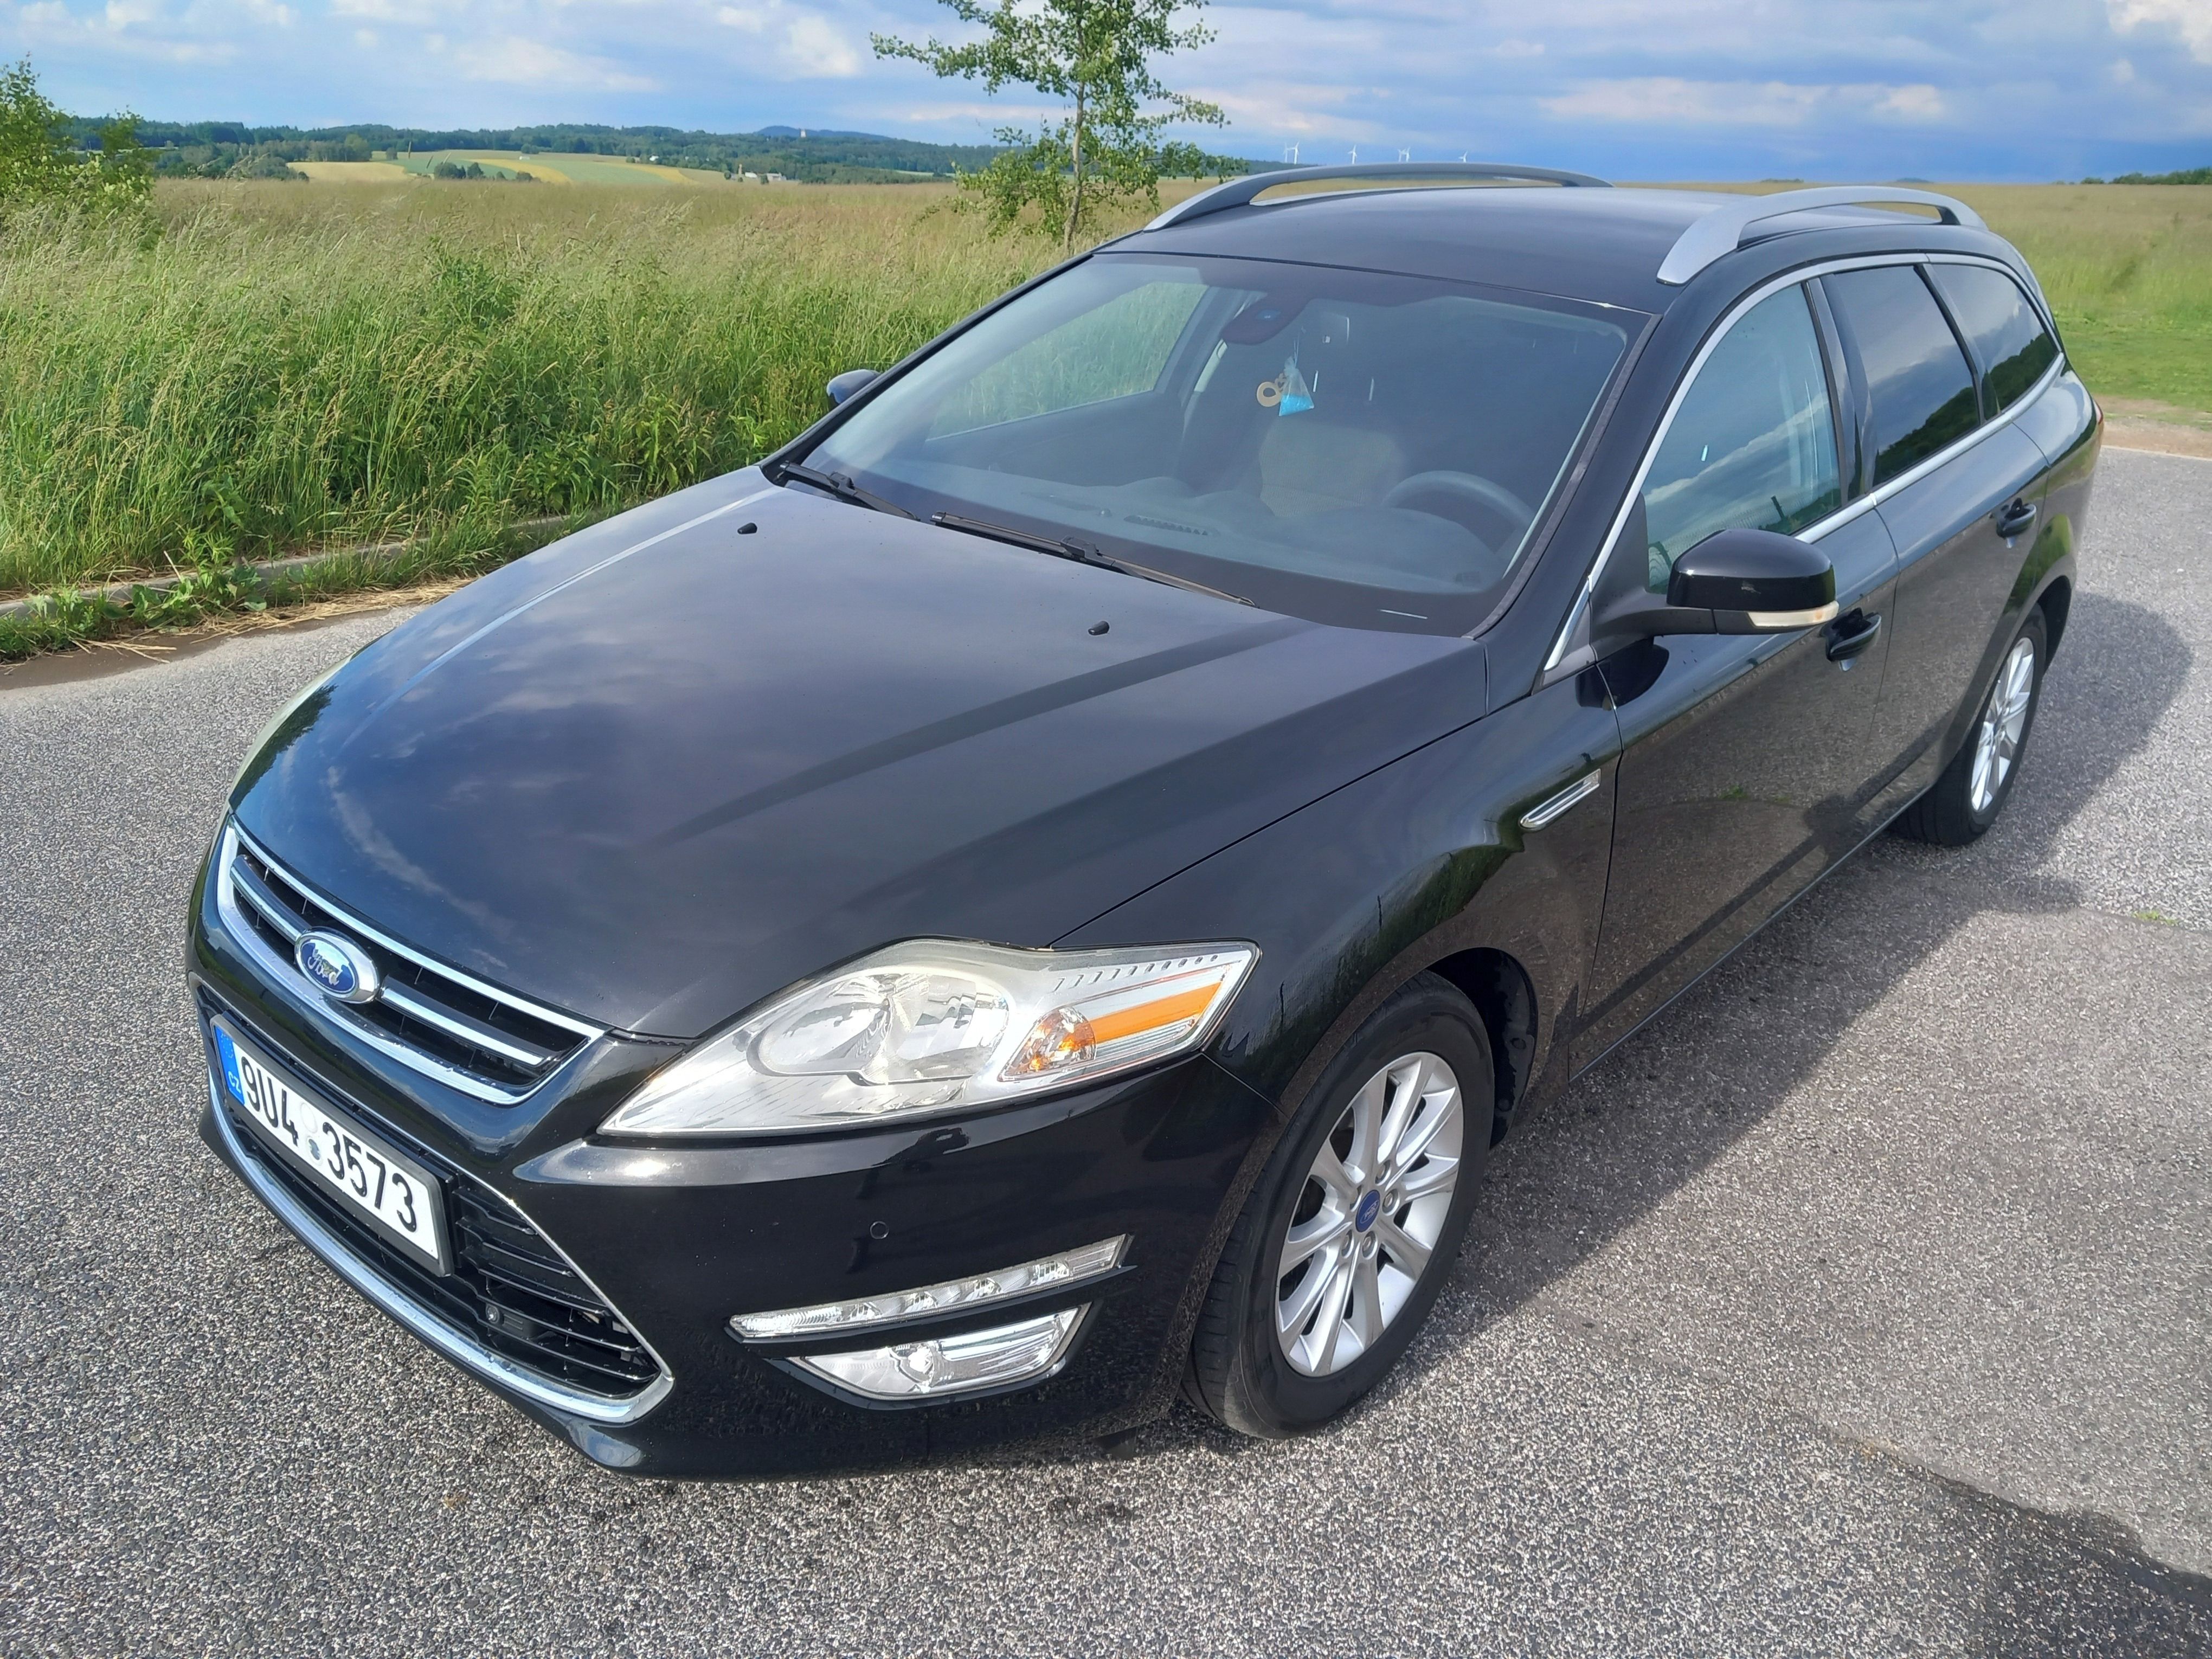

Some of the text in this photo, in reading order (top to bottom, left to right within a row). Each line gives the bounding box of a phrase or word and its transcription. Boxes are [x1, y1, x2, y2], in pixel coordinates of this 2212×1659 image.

[228, 1071, 242, 1094] CZ
[241, 1056, 416, 1232] 9U4 3573
